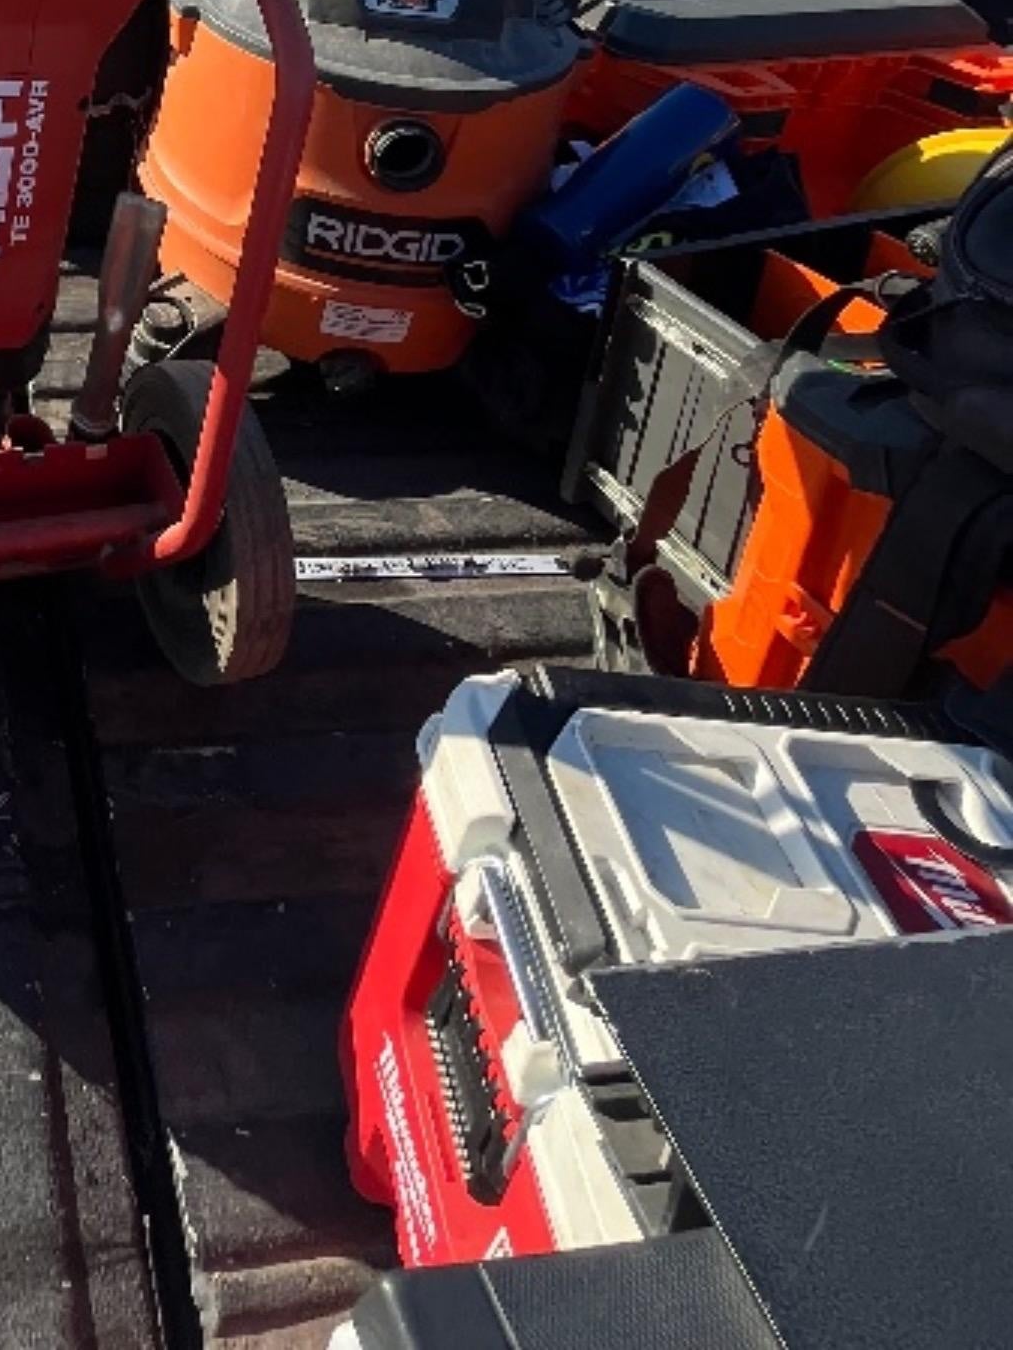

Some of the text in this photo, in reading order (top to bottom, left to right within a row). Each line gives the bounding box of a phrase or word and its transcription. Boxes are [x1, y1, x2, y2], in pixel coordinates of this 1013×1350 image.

[10, 80, 49, 245] TE 3000-AVR
[307, 212, 465, 262] RIDGID
